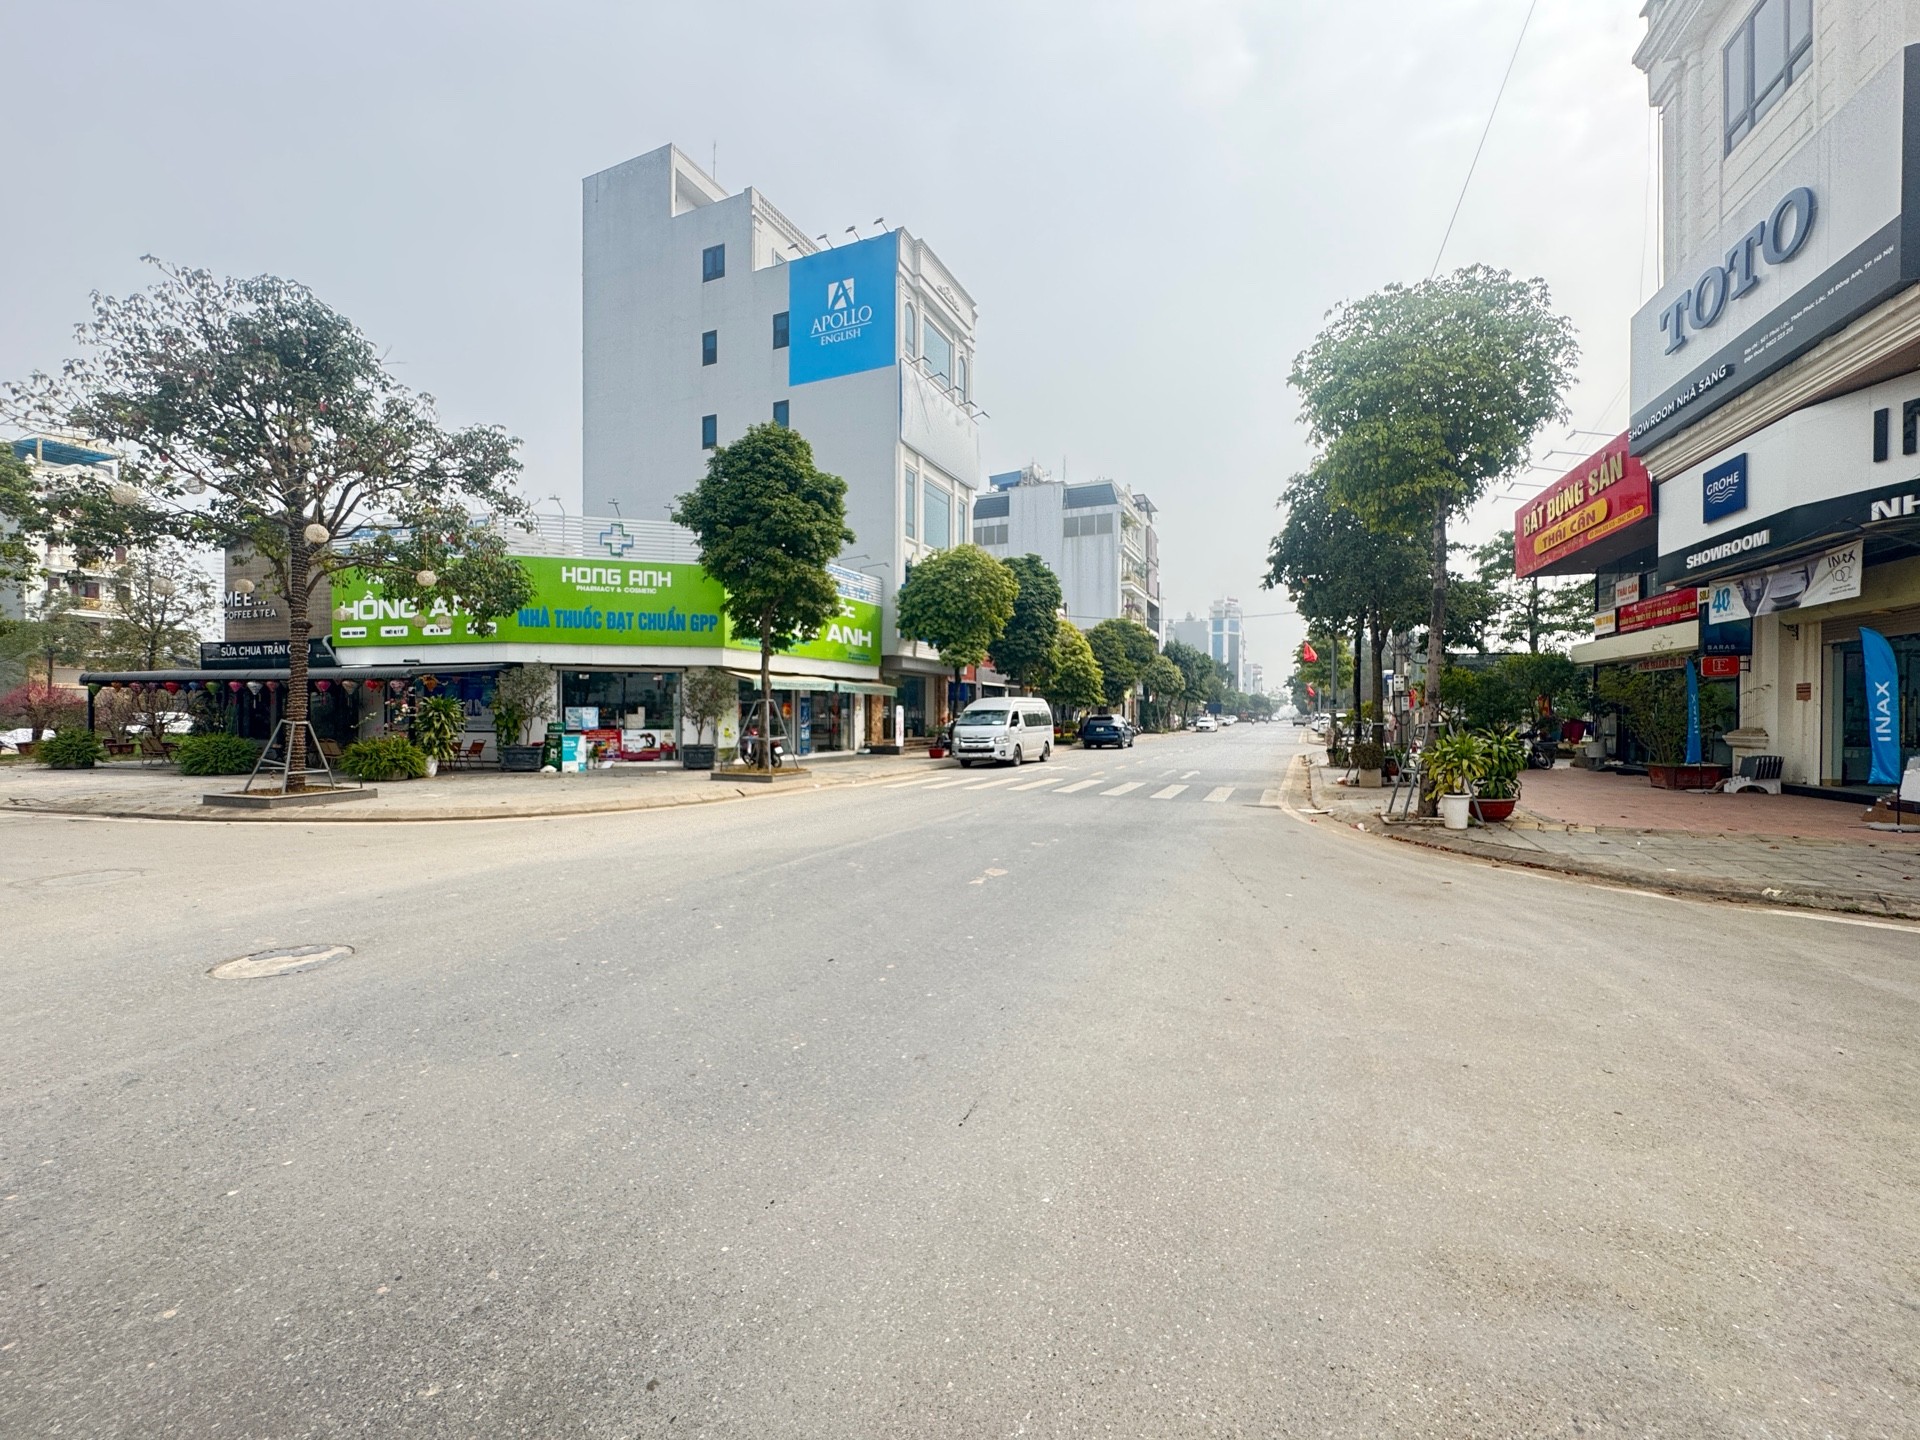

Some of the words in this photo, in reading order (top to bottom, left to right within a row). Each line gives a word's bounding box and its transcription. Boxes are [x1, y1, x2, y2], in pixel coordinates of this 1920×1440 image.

[1659, 187, 1817, 356] TOTO
[811, 305, 872, 334] APOLLO
[820, 327, 861, 346] ENGLISH
[1628, 401, 1675, 442] SHOWROOM
[1676, 382, 1697, 410] NHÀ
[1698, 363, 1728, 393] SANG
[1523, 501, 1545, 538] BẤT
[1588, 451, 1623, 496] SẢN
[1706, 471, 1740, 497] GROHE
[1542, 523, 1567, 549] THÁI
[1686, 529, 1770, 570] SHOWROOM
[576, 584, 615, 593] PHARMACY
[624, 586, 657, 595] COSMETIC
[224, 609, 250, 620] COFFEE
[253, 609, 258, 617] &
[261, 608, 277, 618] TEA
[341, 590, 420, 621] HỒNG
[429, 594, 476, 618] AN
[518, 605, 550, 628] NHÀ
[554, 605, 602, 630] THUỐC
[606, 611, 634, 634] ĐẠT
[638, 606, 686, 632] CHUẨN
[690, 613, 718, 632] GPP
[221, 644, 237, 657] SỮA
[239, 645, 261, 656] CHUA
[263, 642, 285, 655] TRÂN
[826, 623, 872, 648] ANH
[1875, 681, 1892, 742] INAX
